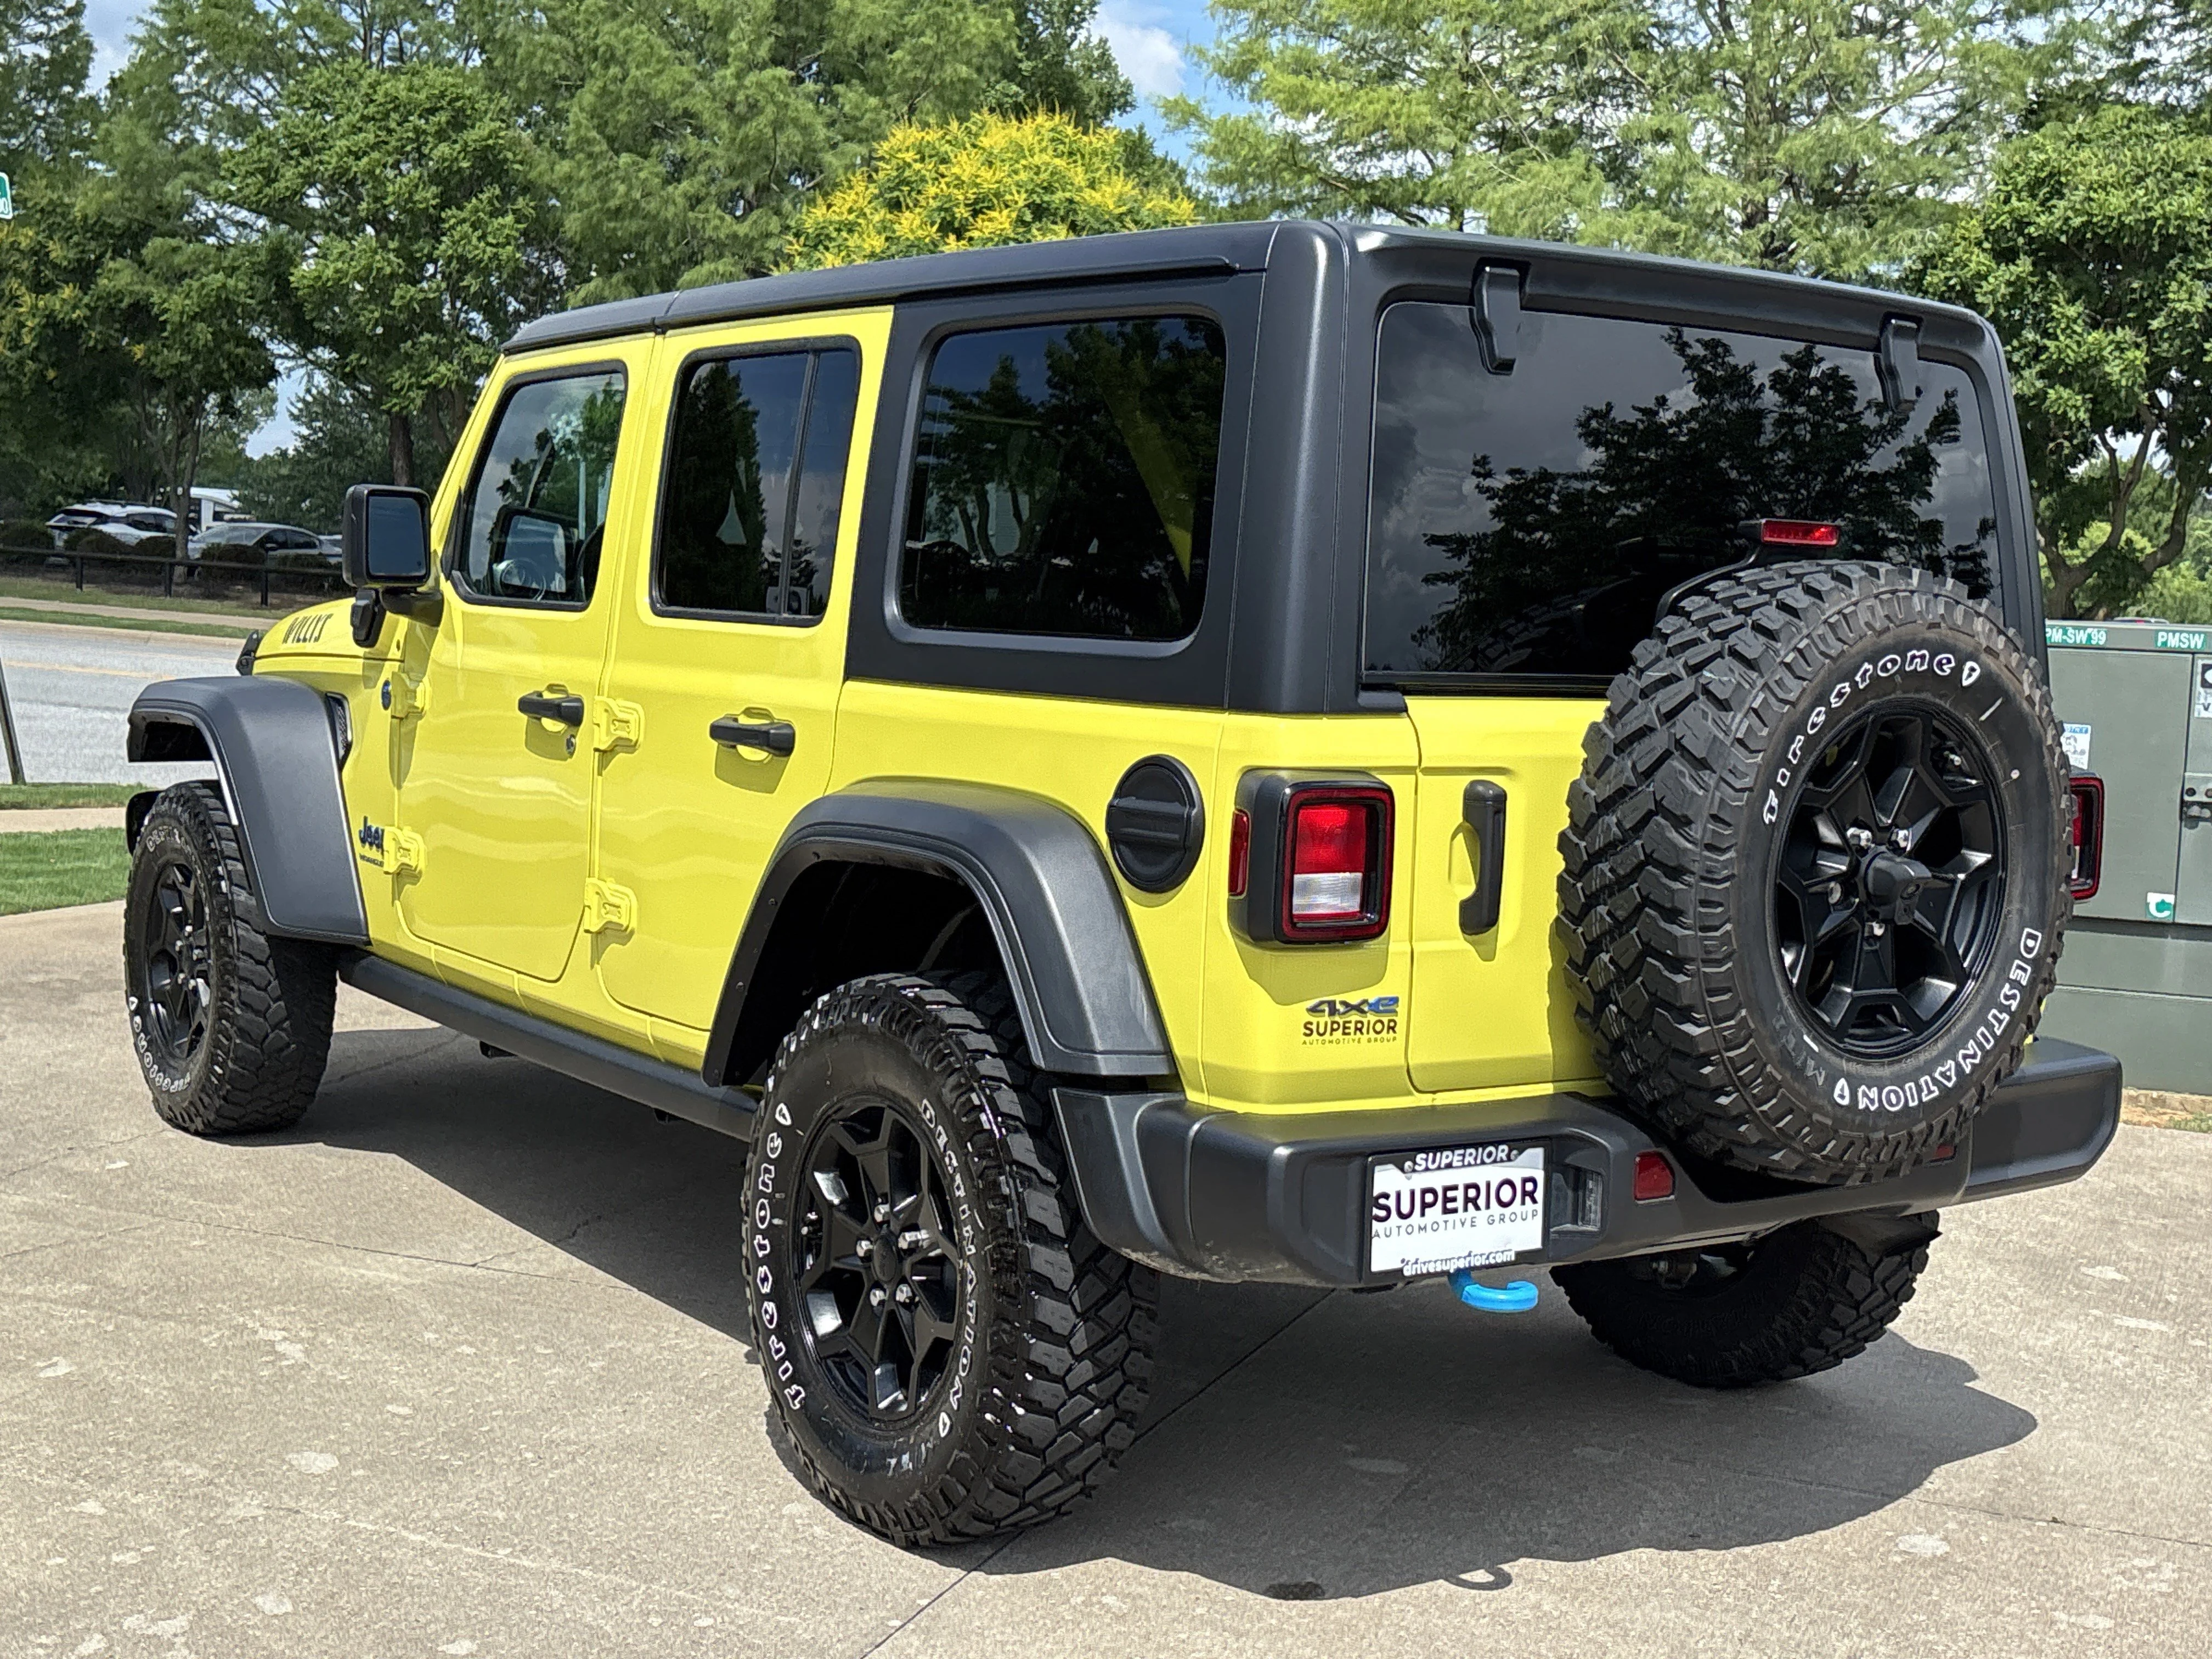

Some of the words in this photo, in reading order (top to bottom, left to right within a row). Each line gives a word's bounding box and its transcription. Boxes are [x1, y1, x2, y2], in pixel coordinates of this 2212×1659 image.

[2157, 631, 2204, 650] PMSW
[1763, 650, 1955, 824] Firestone
[1302, 1019, 1397, 1037] SUPERIOR
[1858, 928, 2042, 1111] DESTINATION
[1413, 1144, 1509, 1171] SUPERIOR
[1372, 1176, 1538, 1223] SUPERIOR
[1372, 1216, 1477, 1239] AUTOMOTIVE
[1487, 1209, 1538, 1226] GROUP
[921, 1098, 977, 1411] DESTINATION
[1402, 1249, 1515, 1277] drivesuperior.com
